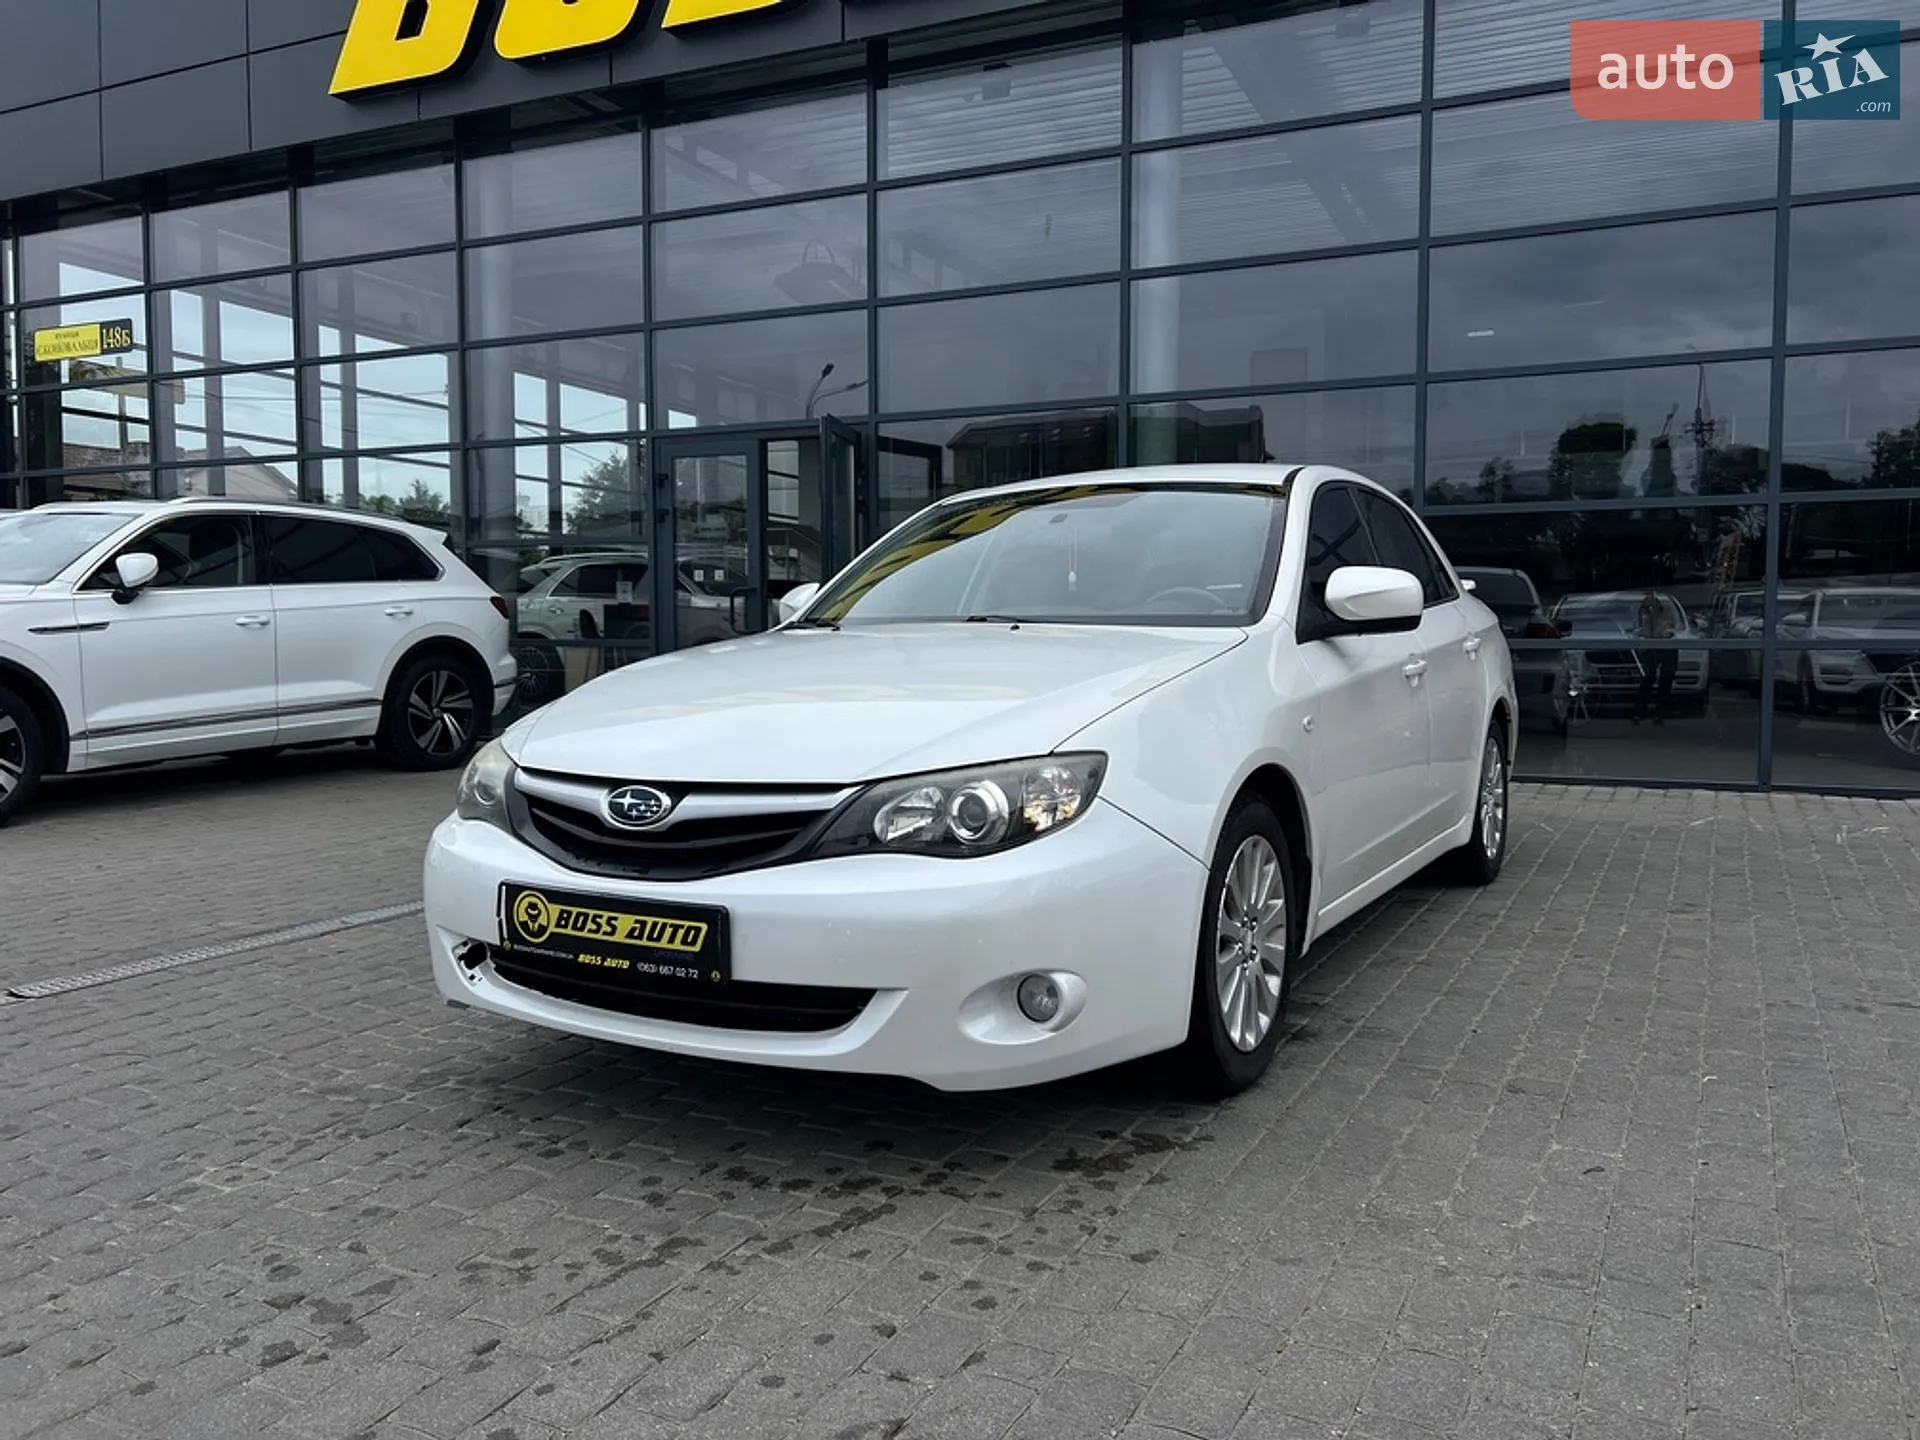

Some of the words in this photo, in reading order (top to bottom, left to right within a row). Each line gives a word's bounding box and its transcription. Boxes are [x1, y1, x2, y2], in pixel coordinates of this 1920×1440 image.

[102, 326, 131, 349] 148Б
[555, 908, 619, 937] BOSS
[625, 918, 703, 947] AUTO
[577, 953, 603, 966] BOSS
[603, 956, 631, 969] AUTO
